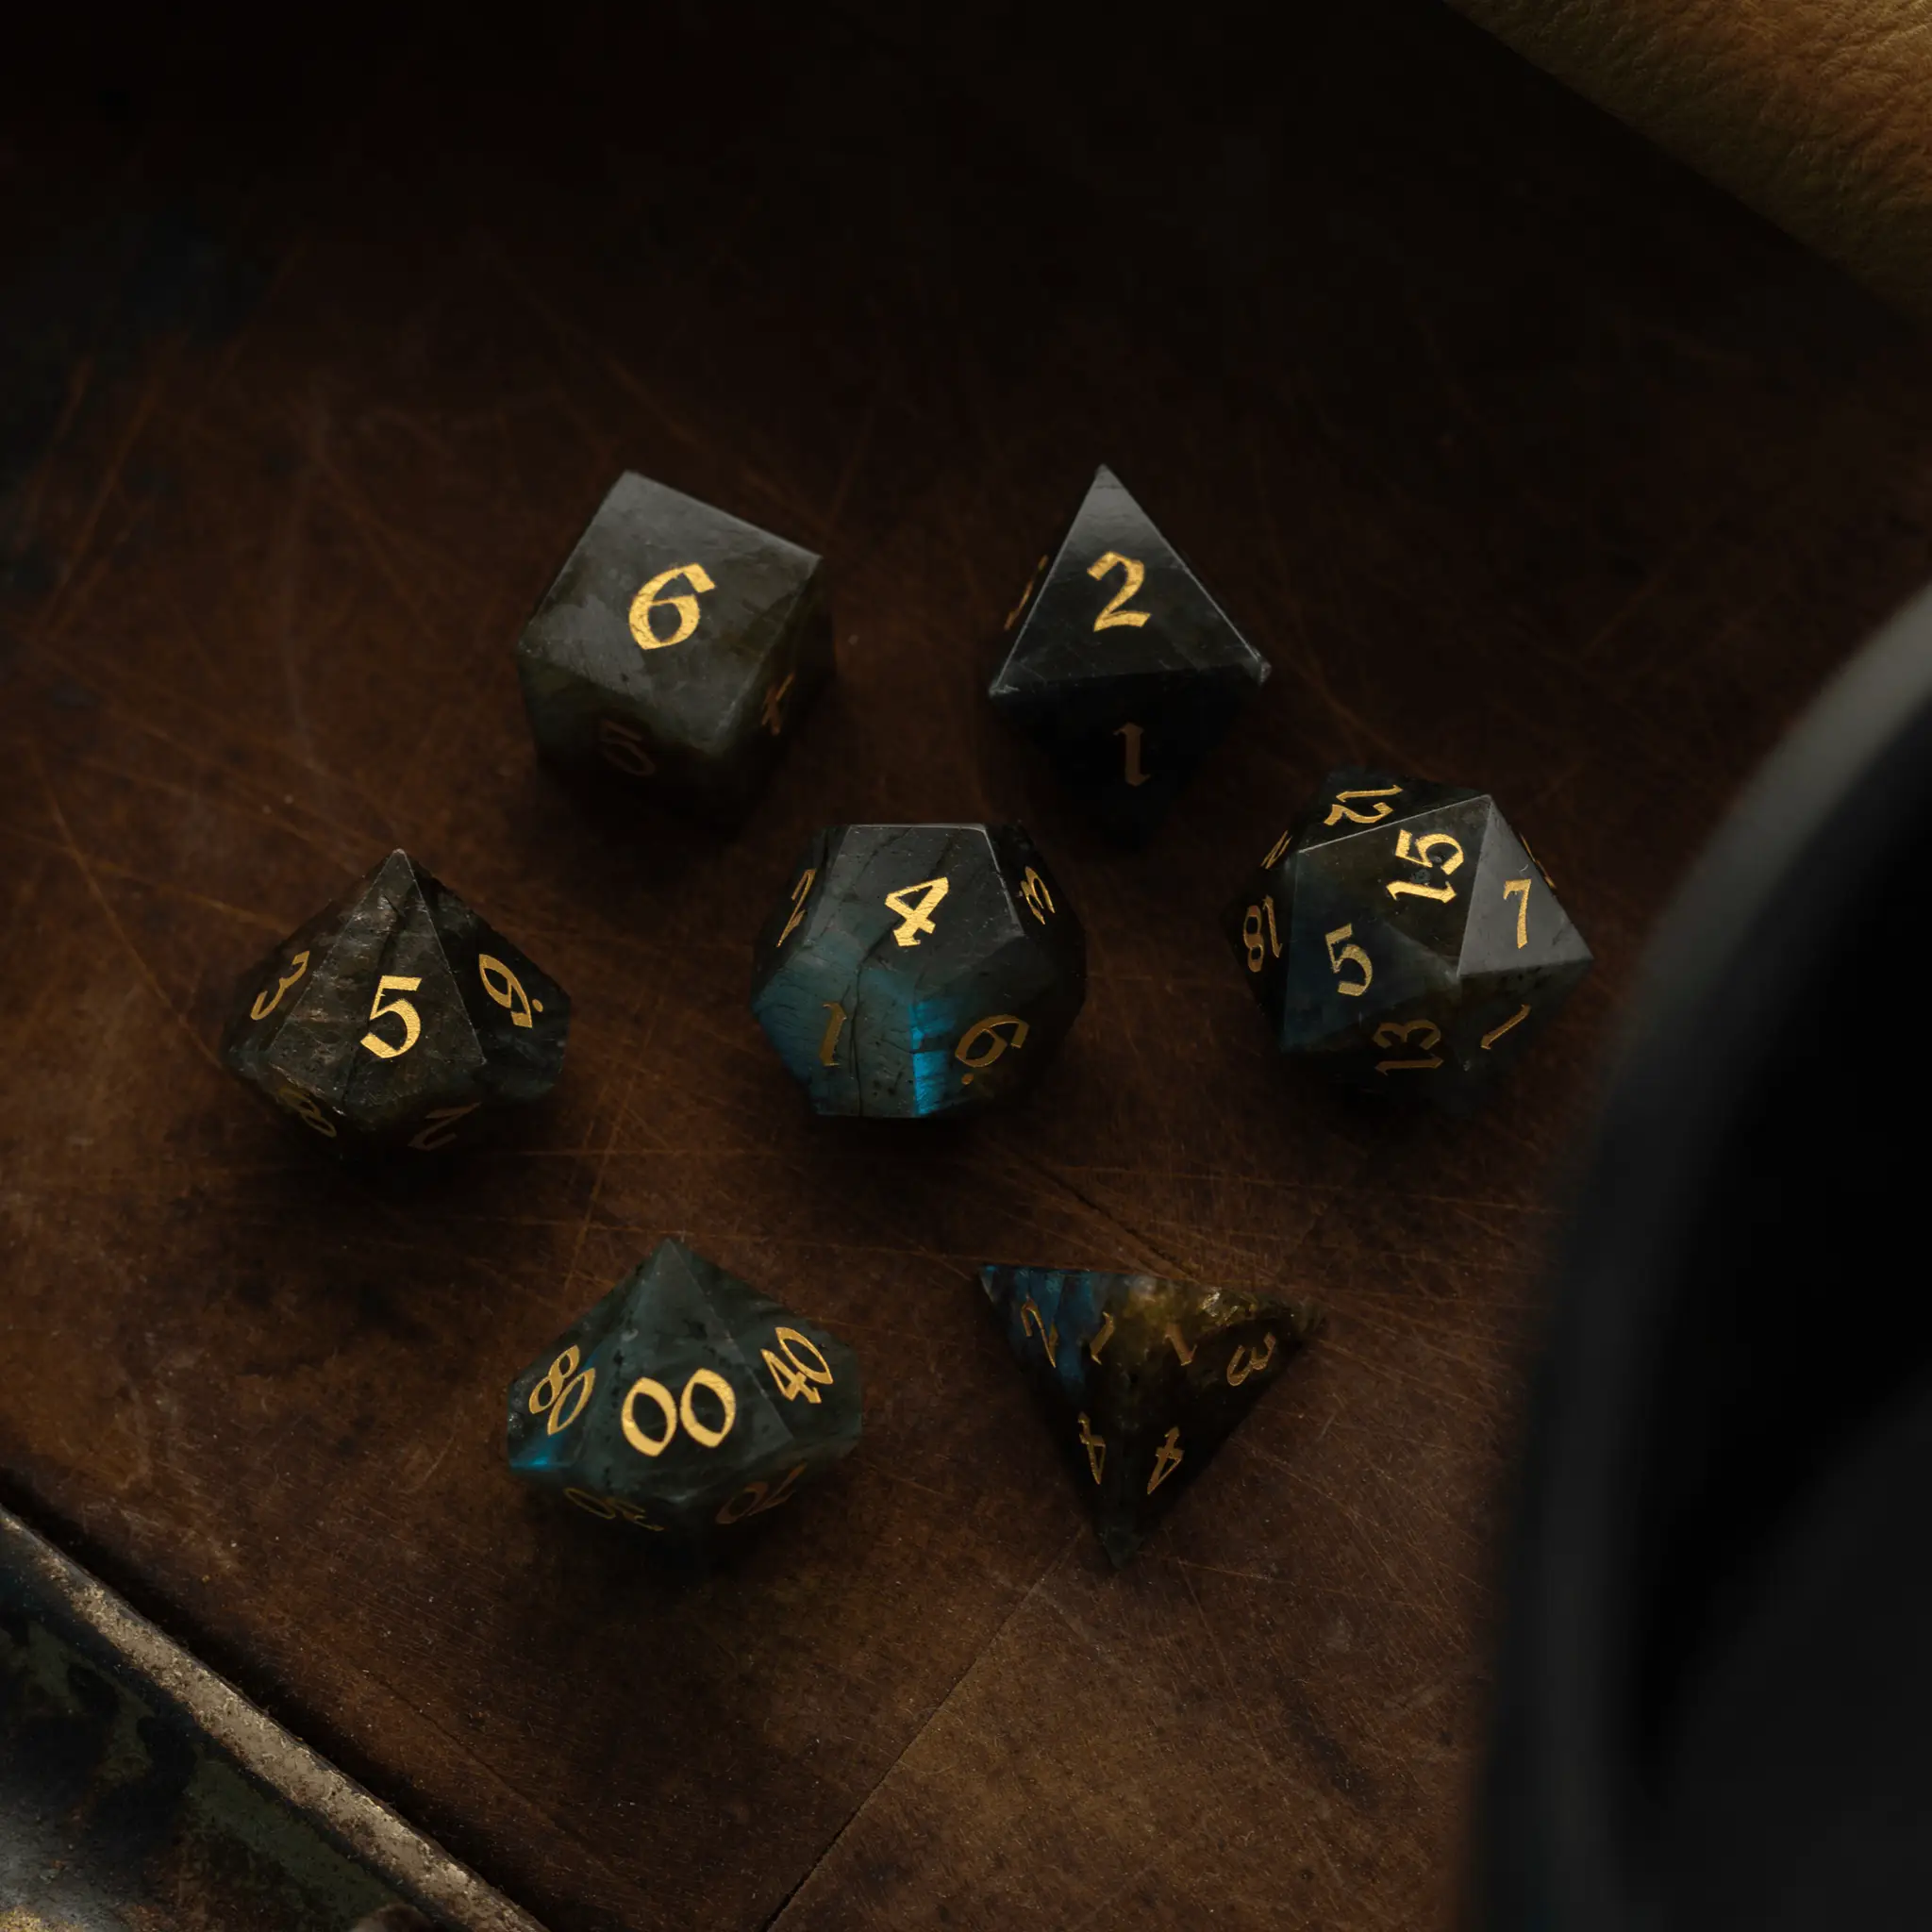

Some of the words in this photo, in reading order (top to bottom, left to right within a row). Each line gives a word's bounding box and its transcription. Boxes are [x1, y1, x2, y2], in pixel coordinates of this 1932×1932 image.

[628, 562, 717, 650] 6
[1087, 551, 1151, 632] 2
[1113, 721, 1151, 787] 1
[1323, 784, 1404, 826] 12
[1019, 865, 1056, 925] 3
[1386, 829, 1465, 904] 15
[884, 876, 950, 947] 4
[1242, 894, 1283, 974] 18
[1503, 878, 1532, 949] 7
[250, 950, 310, 1021] 3
[1324, 923, 1374, 996] 5
[359, 974, 423, 1059] 5
[819, 1001, 847, 1067] 1
[1372, 1019, 1444, 1075] 13
[528, 1344, 596, 1436] 80
[760, 1326, 834, 1404] 40
[1226, 1332, 1275, 1387] 3
[621, 1367, 737, 1457] 00
[1077, 1411, 1107, 1486] 4
[1147, 1425, 1185, 1495] 4
